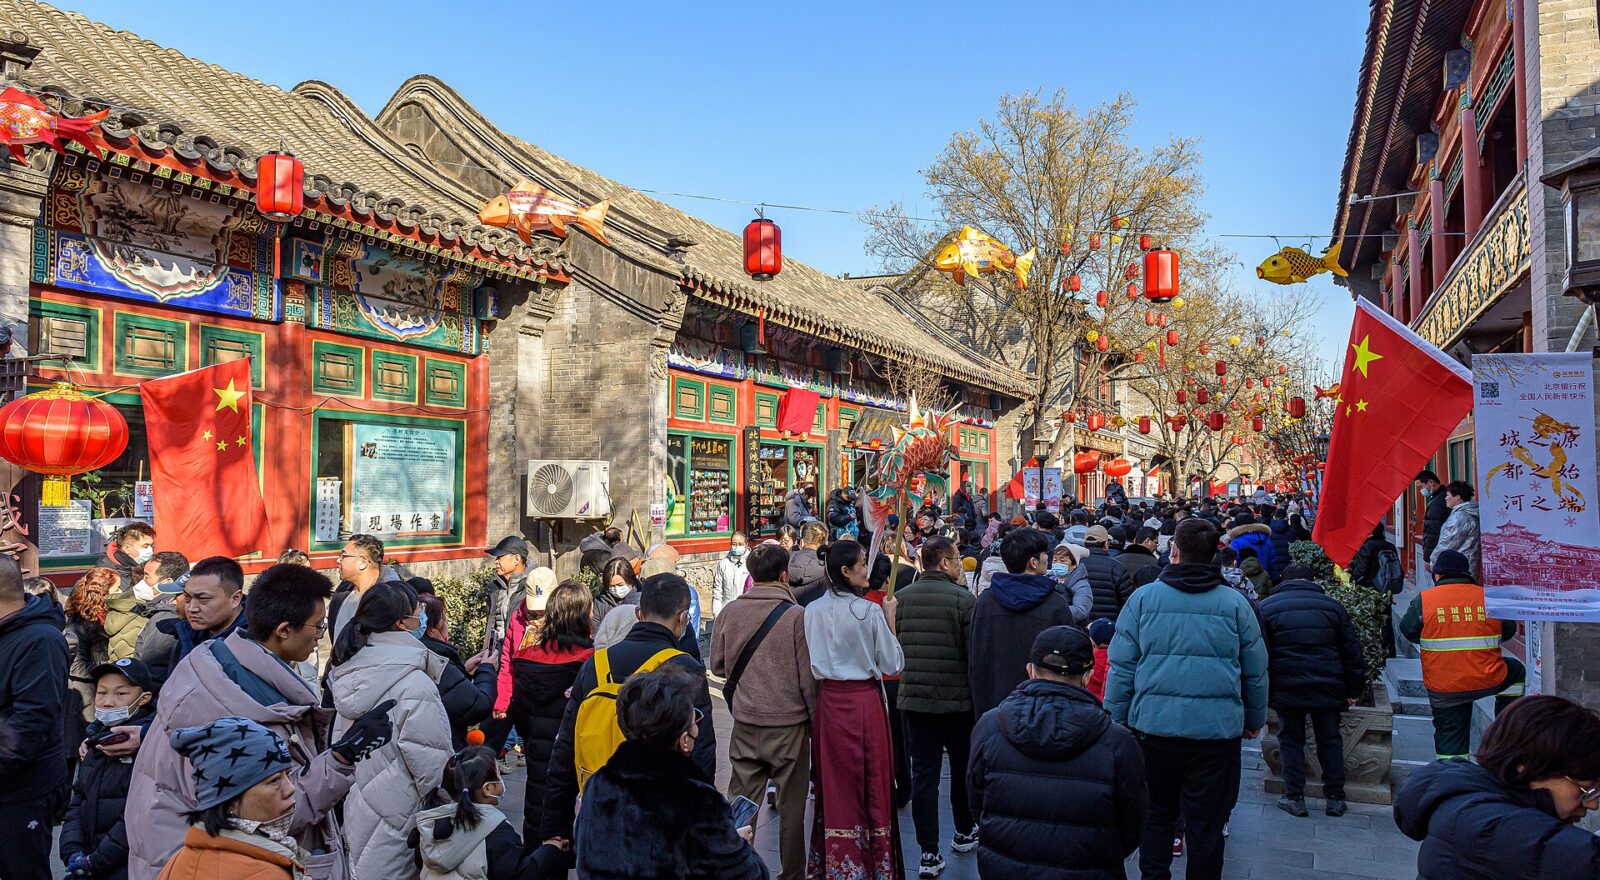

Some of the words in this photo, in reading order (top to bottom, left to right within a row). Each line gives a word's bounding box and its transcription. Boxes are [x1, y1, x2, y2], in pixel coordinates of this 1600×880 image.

[1544, 382, 1587, 391] 北京银行祝
[1519, 393, 1587, 401] 全国人民新年快乐
[1500, 430, 1579, 449] 城之源
[1502, 461, 1580, 481] 都之始
[1503, 494, 1583, 513] 河之端
[368, 513, 441, 531] 現場作畫
